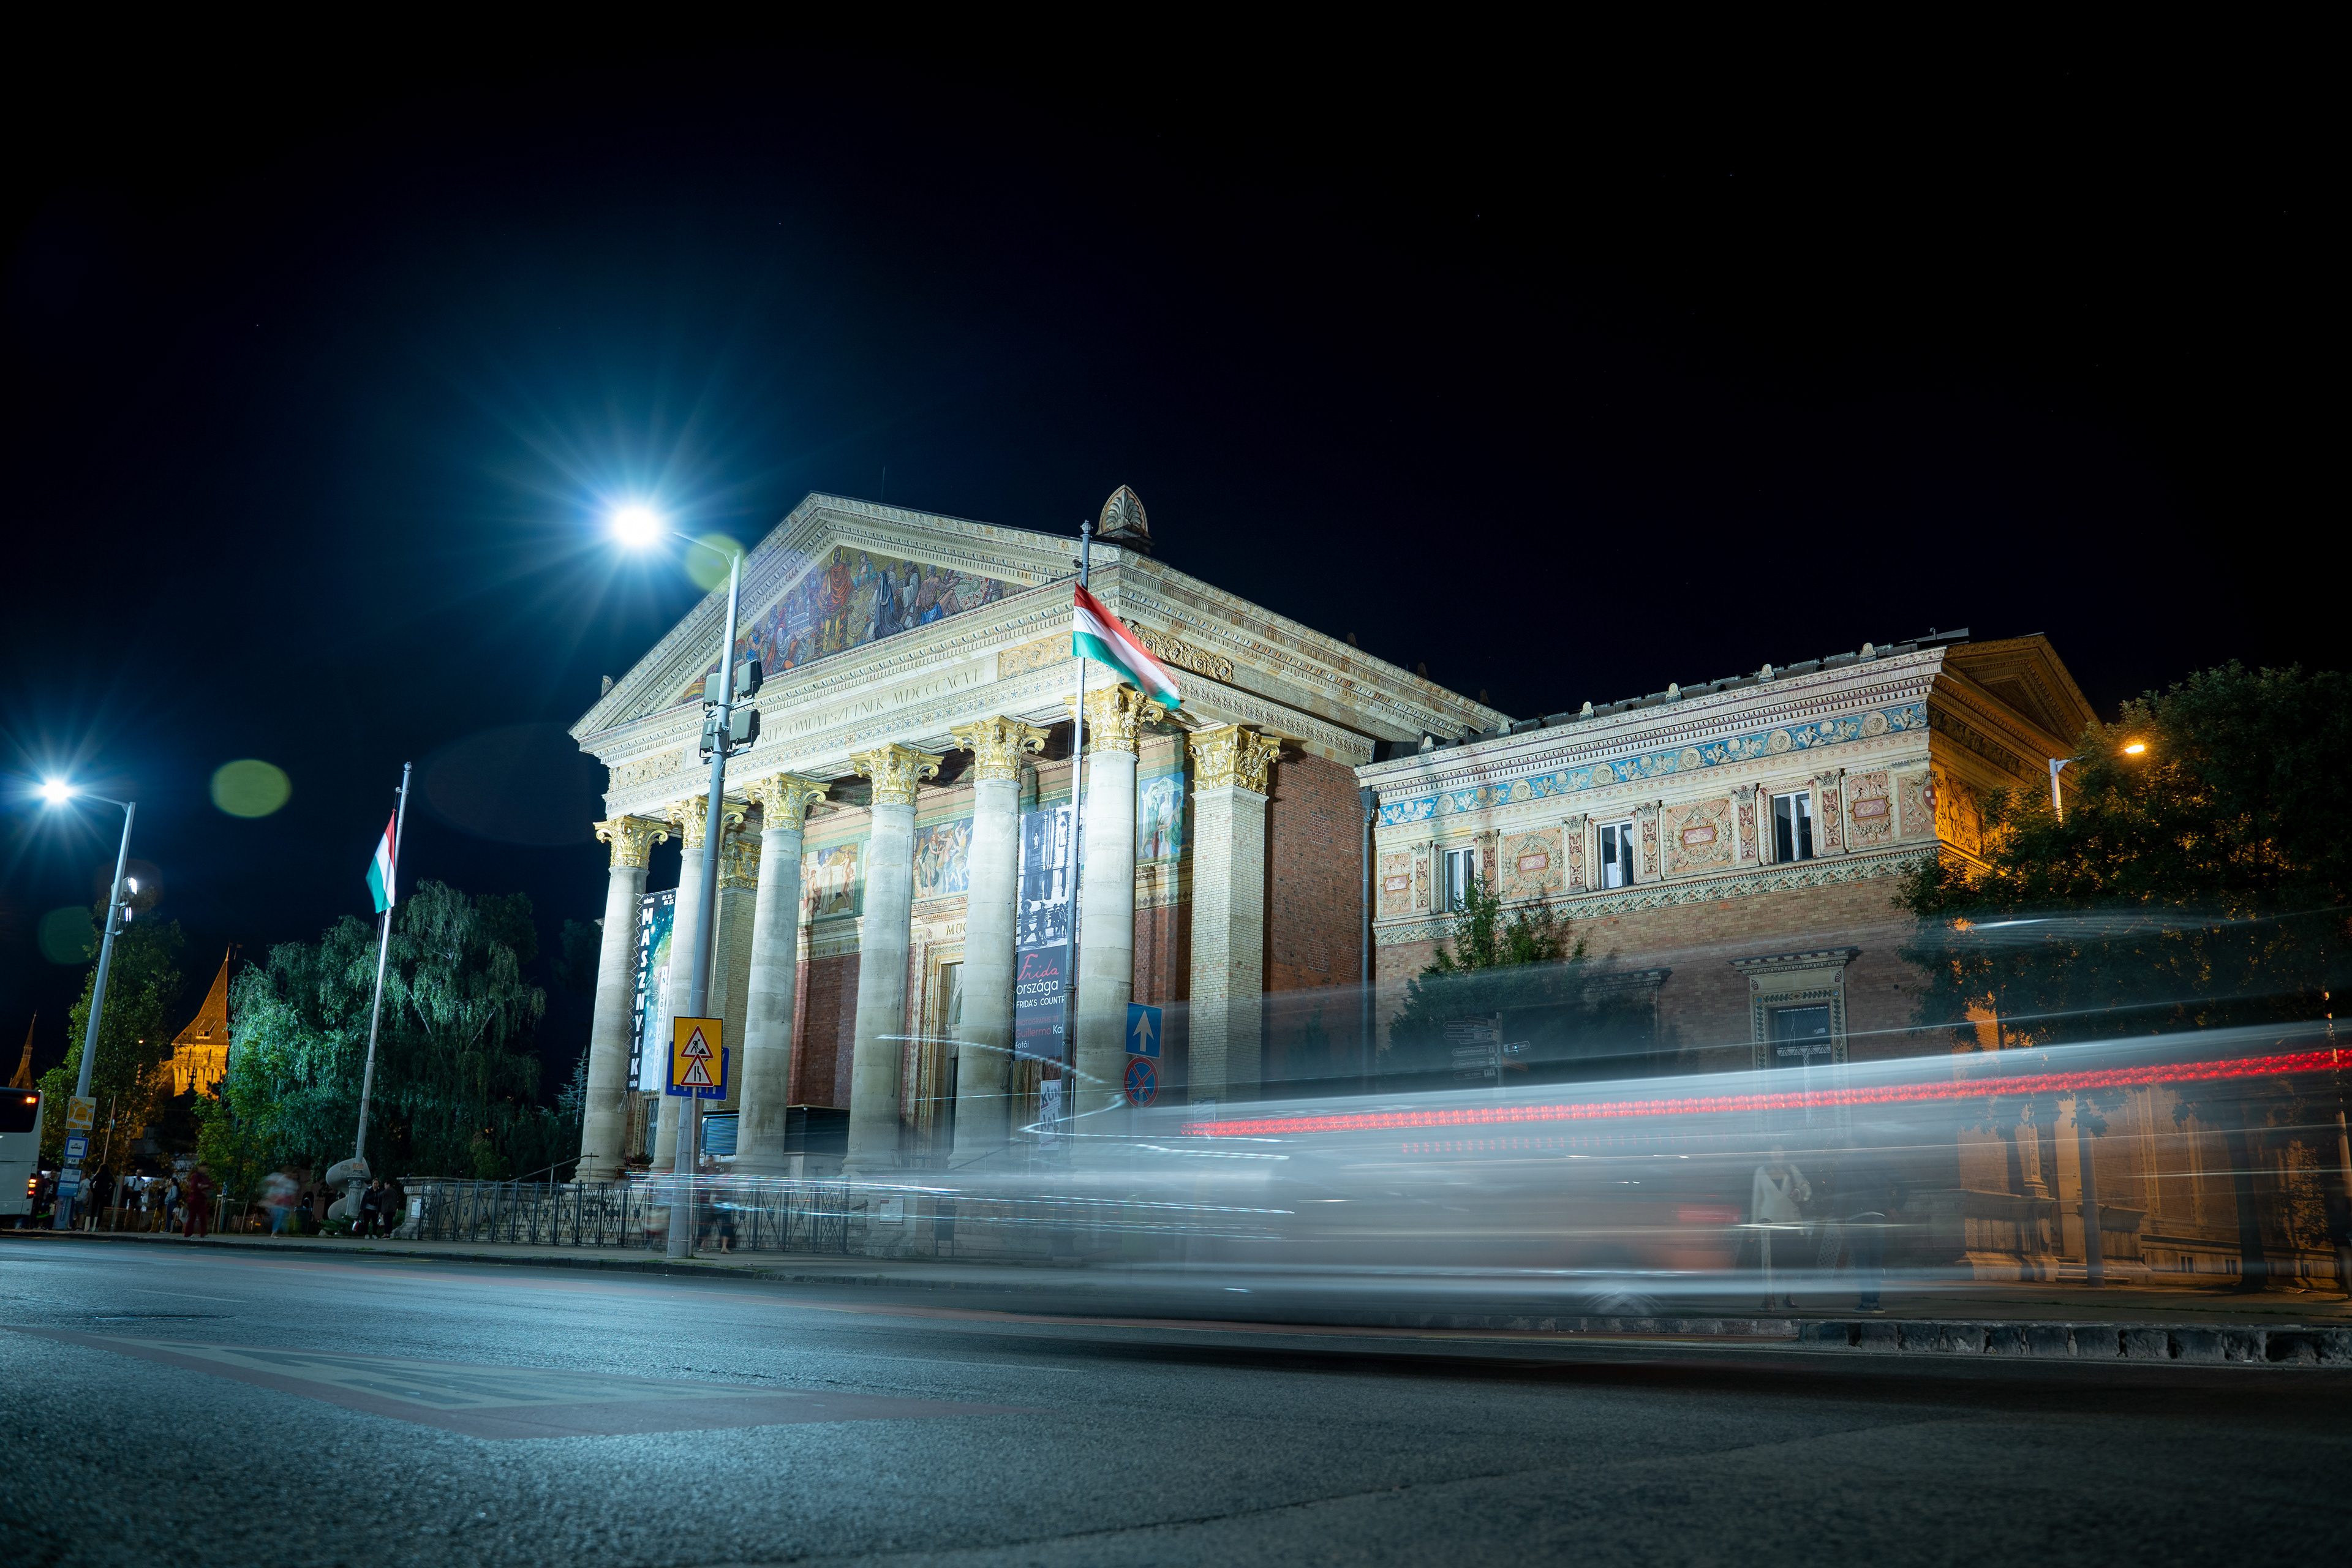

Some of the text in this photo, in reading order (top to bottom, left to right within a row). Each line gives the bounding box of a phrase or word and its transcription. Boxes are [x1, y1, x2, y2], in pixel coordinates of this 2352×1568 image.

[891, 668, 977, 706] MDCCCXCVI
[1017, 954, 1059, 981] Frida
[630, 907, 654, 1076] MASZNYIK
[1016, 979, 1058, 996] országa
[1016, 1016, 1051, 1026] PHOTOGRAPHS
[1016, 1028, 1052, 1038] Guillermo
[1015, 1041, 1030, 1049] fotói
